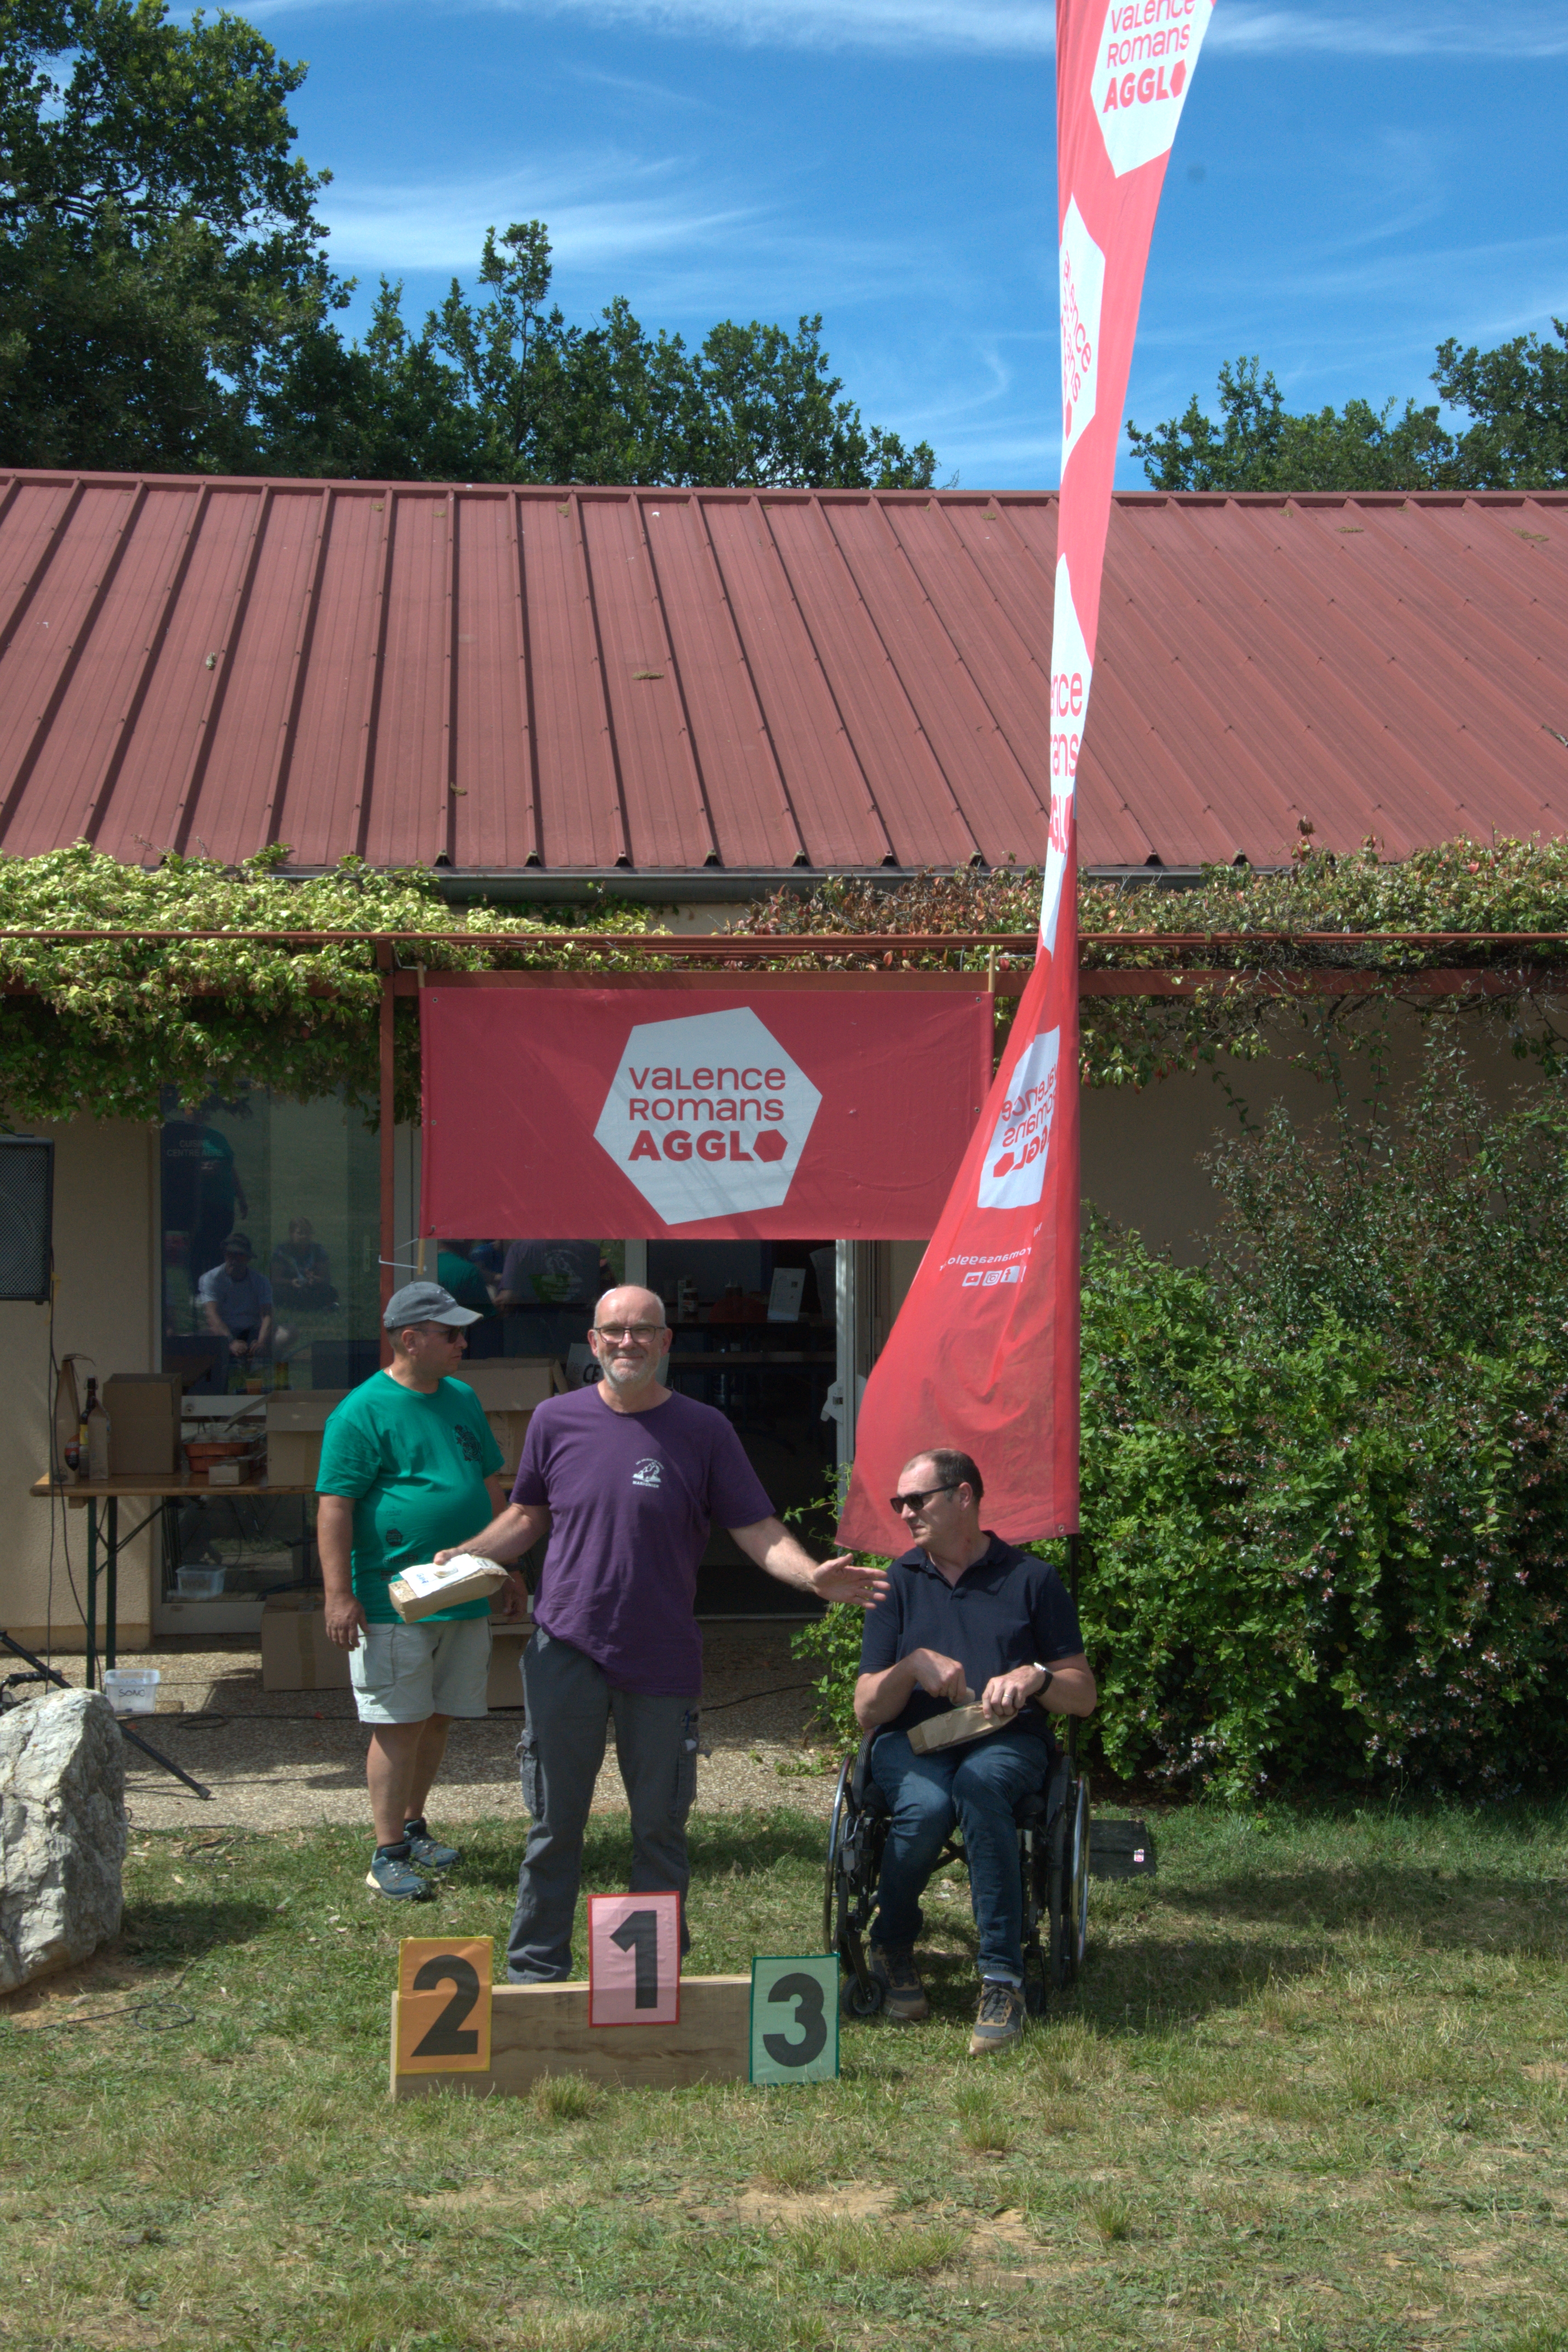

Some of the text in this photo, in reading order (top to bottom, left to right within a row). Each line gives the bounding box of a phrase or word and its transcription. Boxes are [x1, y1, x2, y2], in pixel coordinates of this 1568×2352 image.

[410, 1954, 479, 2057] 2
[609, 1910, 658, 2010] 1
[763, 1972, 827, 2068] 3
